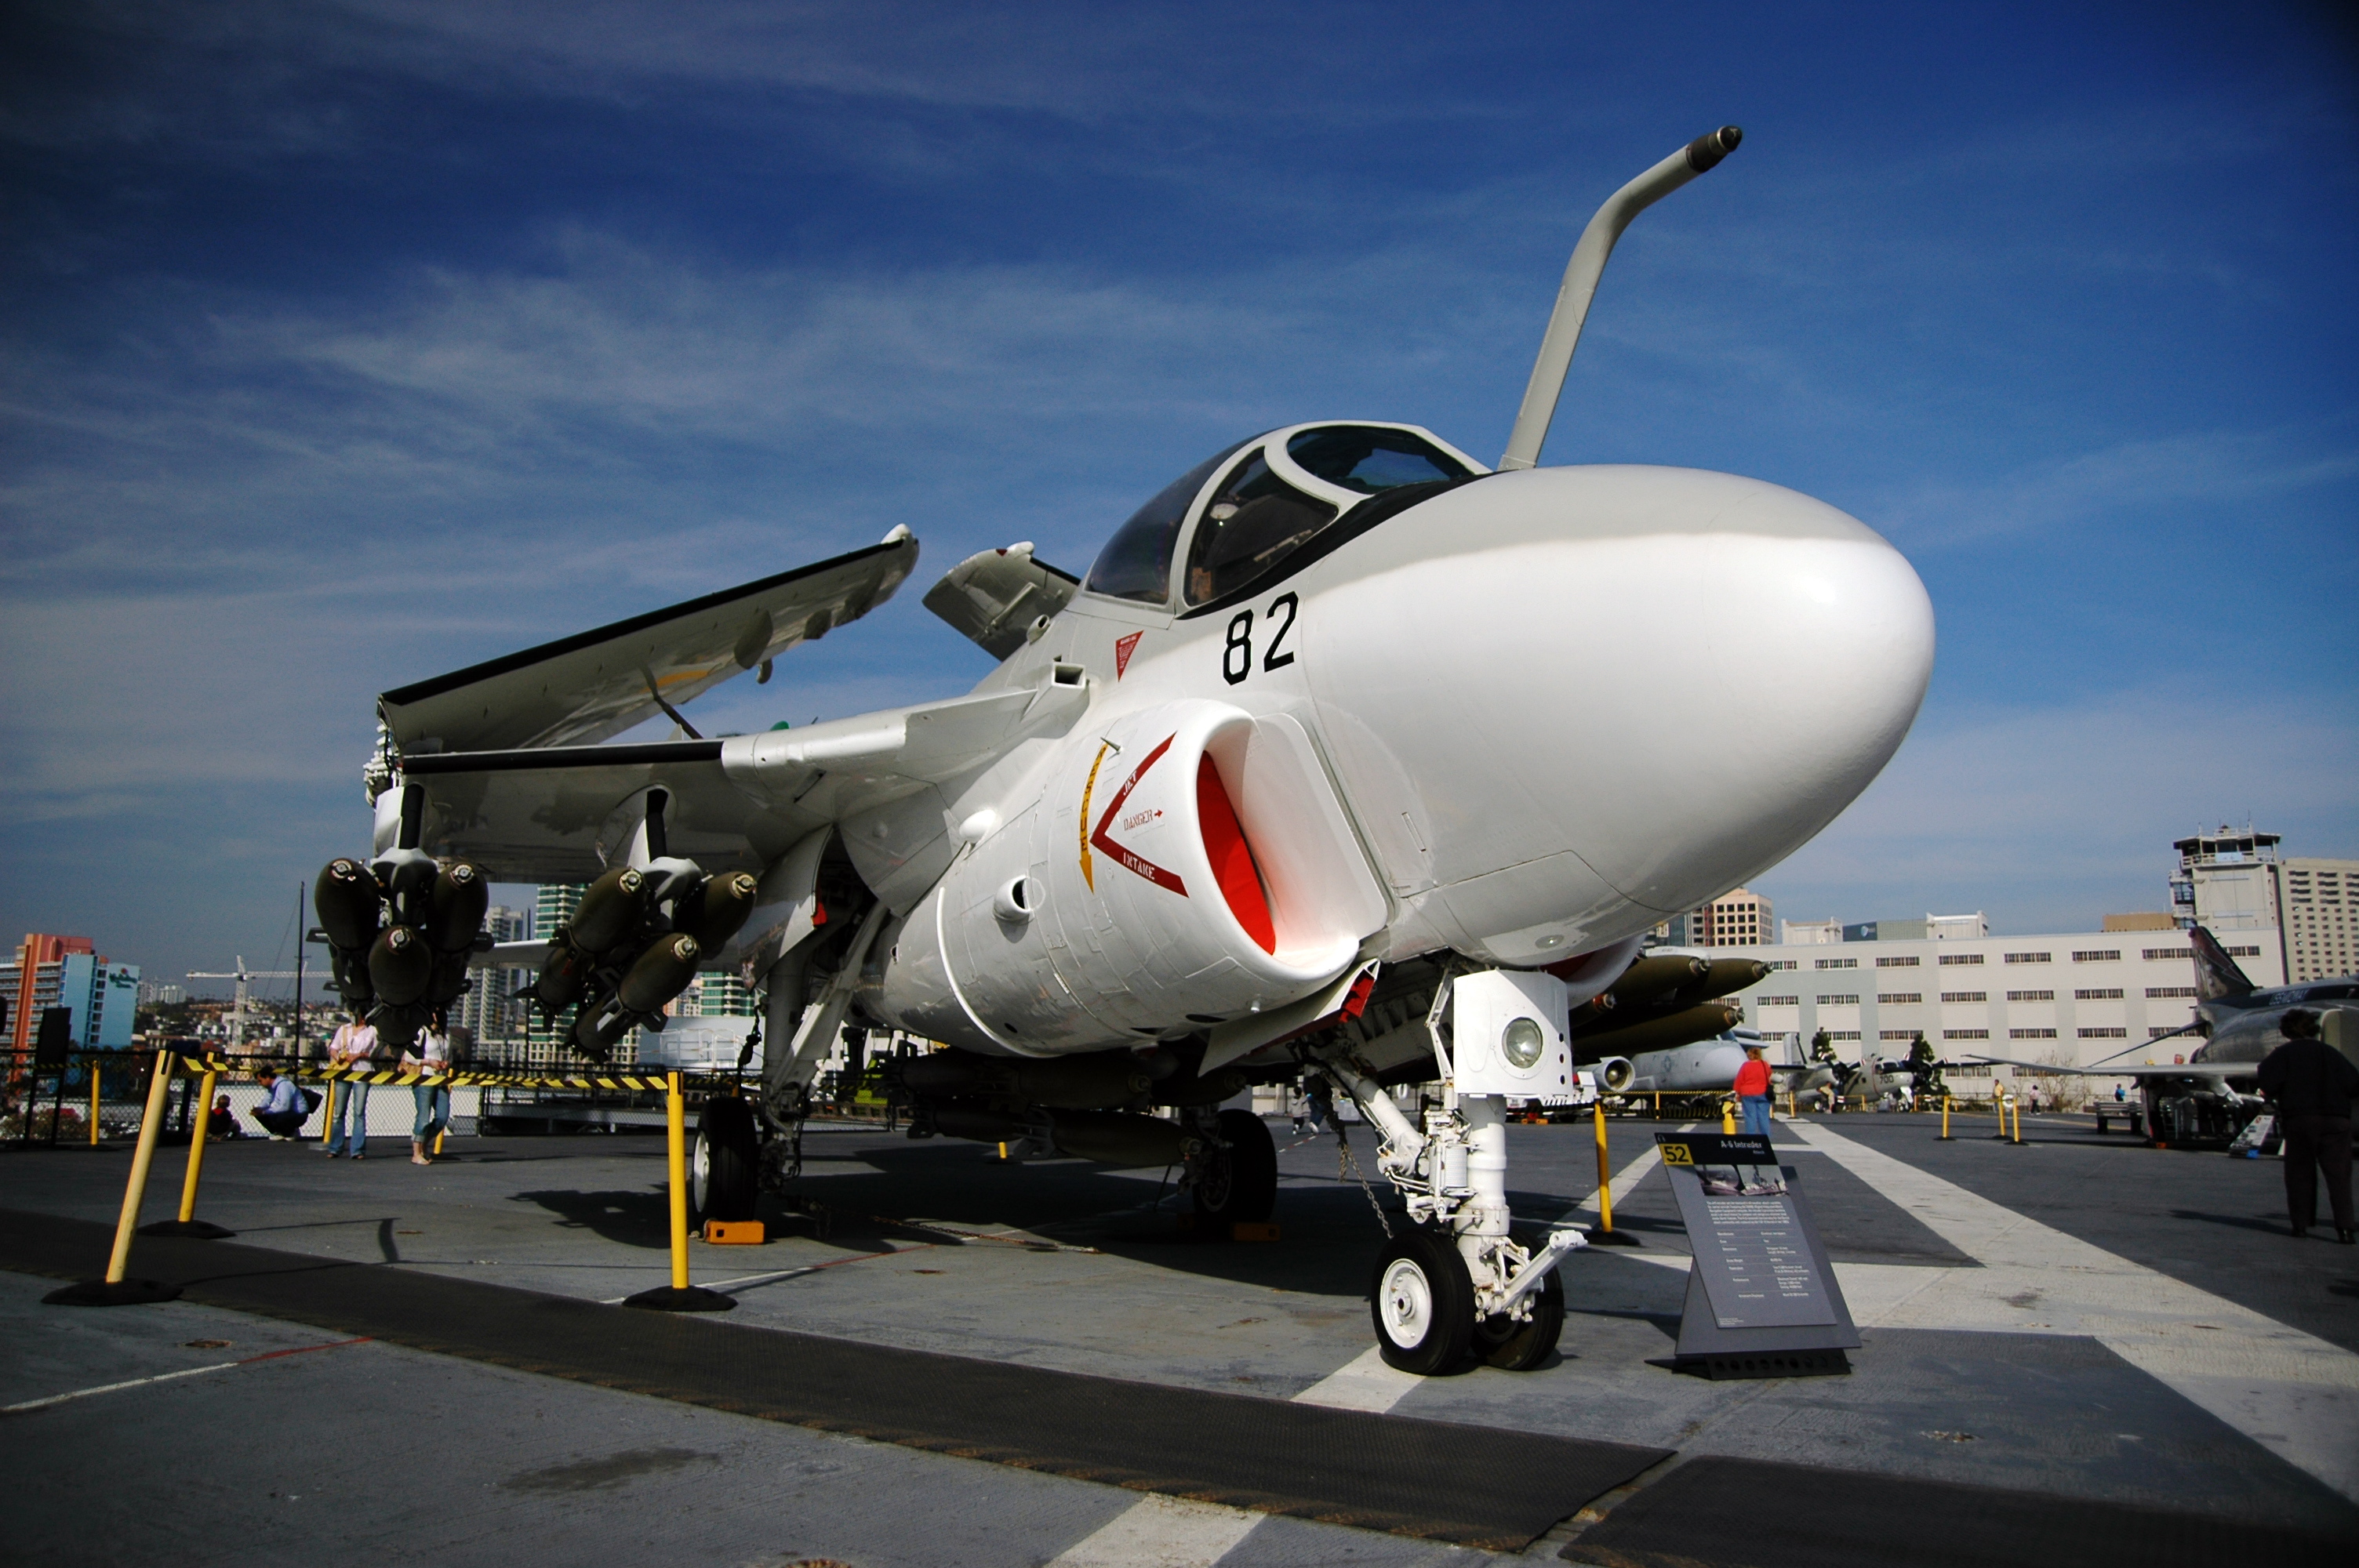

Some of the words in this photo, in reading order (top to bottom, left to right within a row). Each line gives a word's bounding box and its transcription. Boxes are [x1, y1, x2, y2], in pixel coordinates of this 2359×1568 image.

[1223, 590, 1299, 686] 82
[1123, 771, 1137, 797] JET
[1080, 746, 1107, 852] RESCUE
[1123, 809, 1154, 831] DANGER
[1123, 851, 1155, 880] INTAKE
[1880, 1075, 1894, 1084] 700
[1663, 1145, 1689, 1163] 52
[1721, 1140, 1733, 1149] A-6
